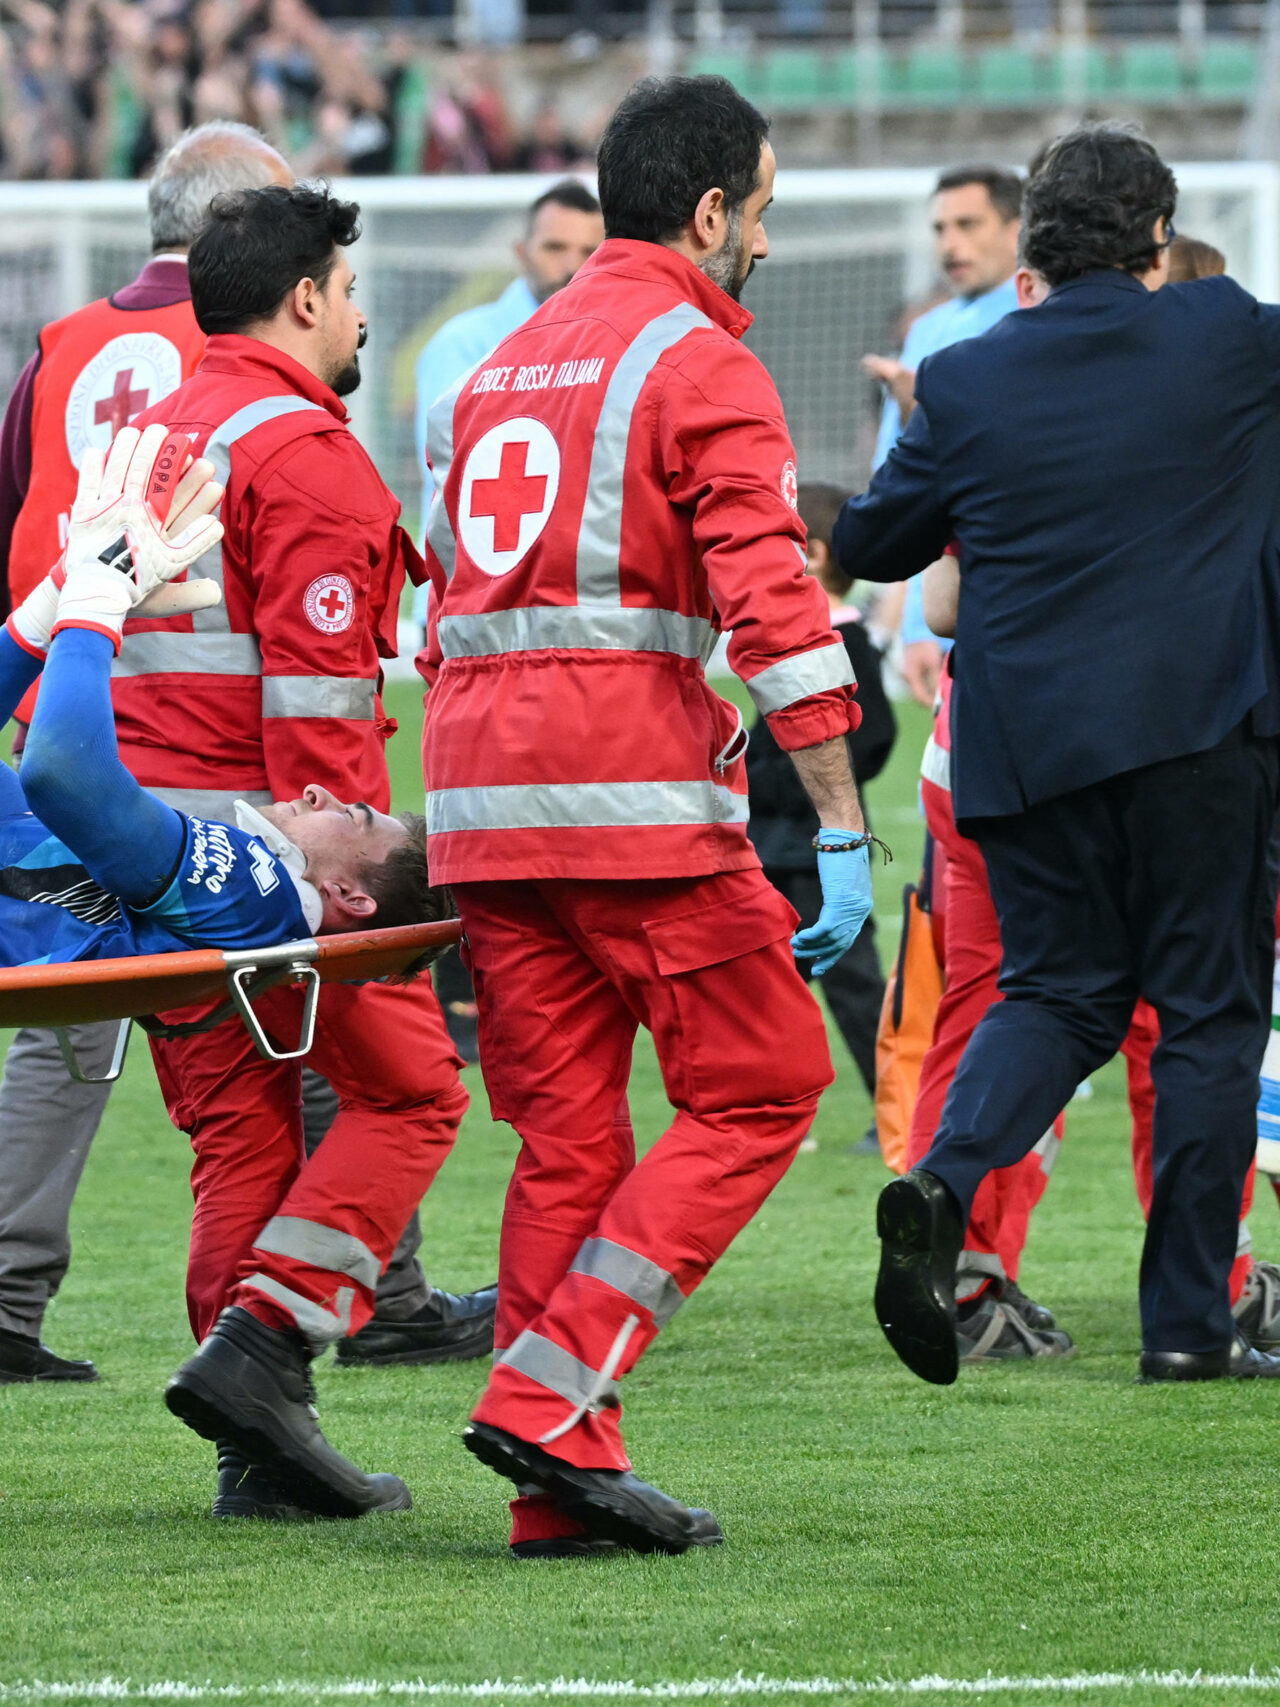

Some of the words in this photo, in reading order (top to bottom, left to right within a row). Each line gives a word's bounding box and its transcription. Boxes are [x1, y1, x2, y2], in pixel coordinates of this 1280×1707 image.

[471, 366, 515, 394] CROCE
[511, 364, 555, 392] ROSSA
[552, 357, 606, 388] ITALIANA
[151, 443, 177, 494] COPA
